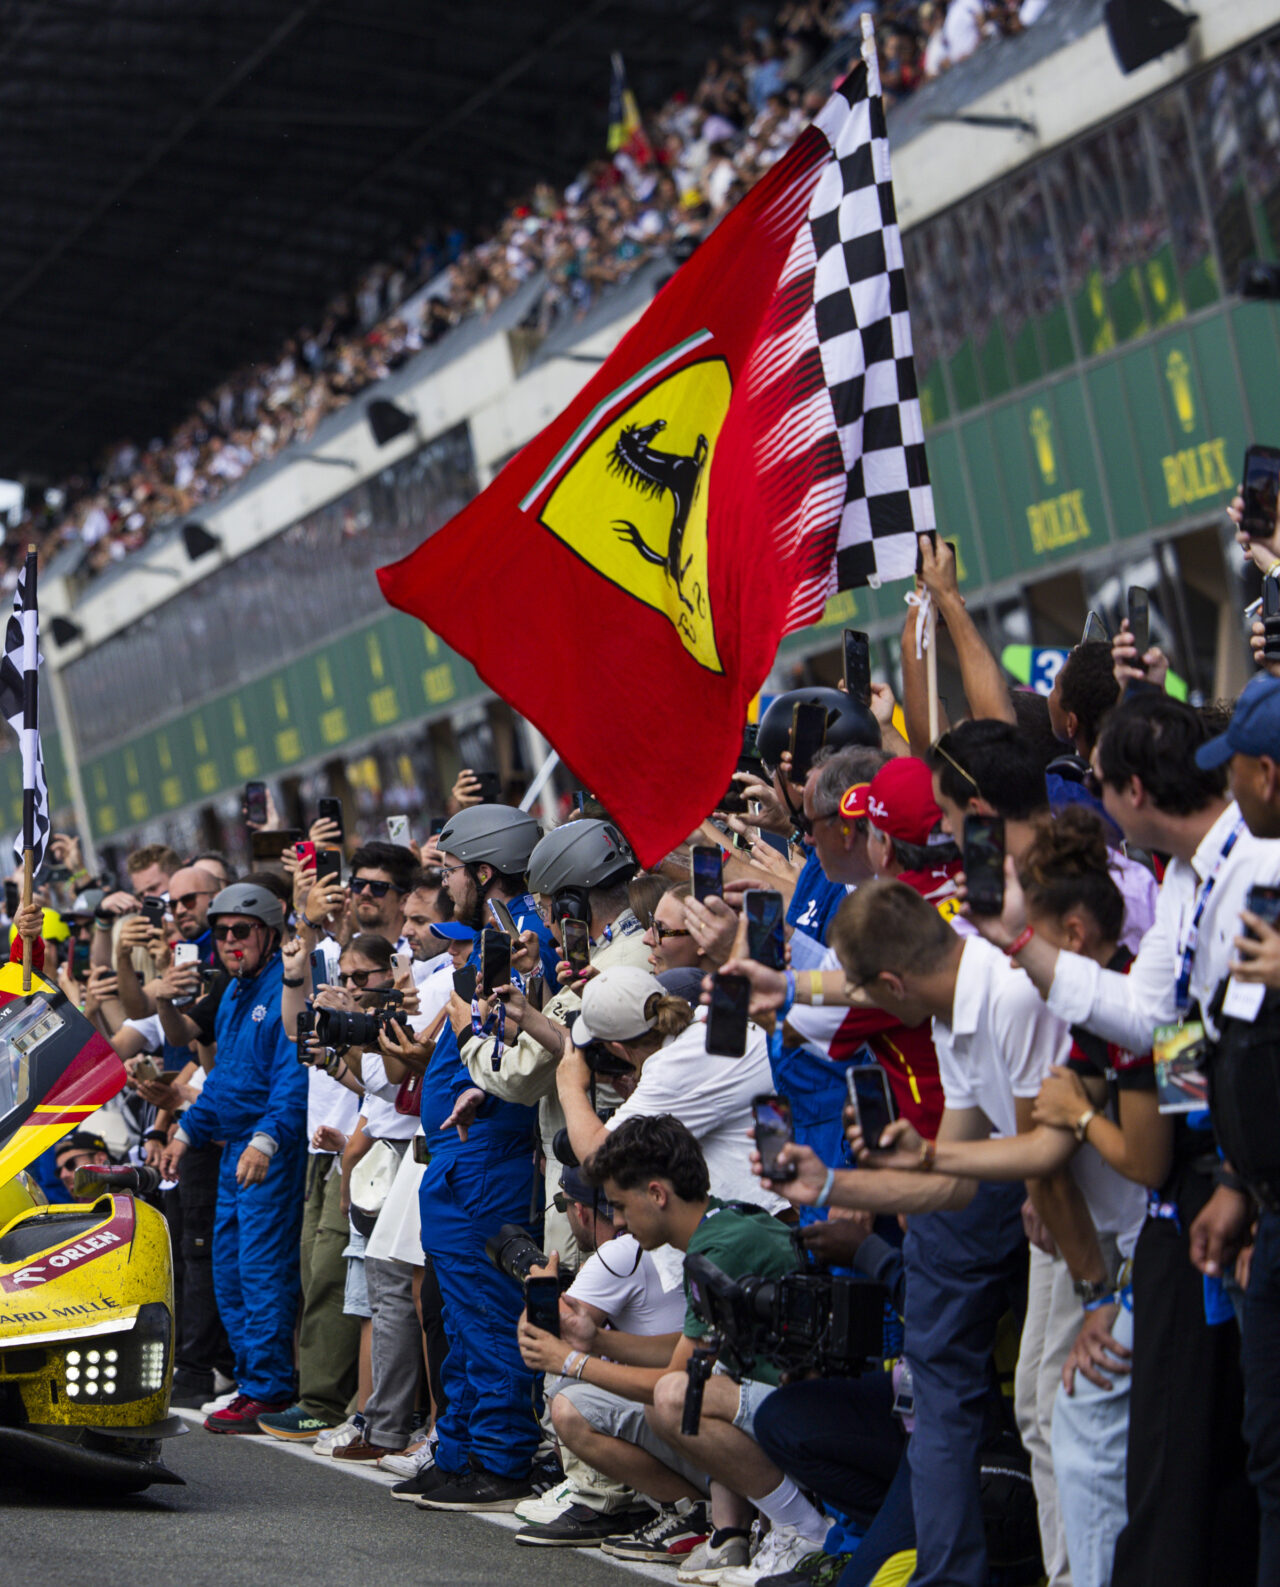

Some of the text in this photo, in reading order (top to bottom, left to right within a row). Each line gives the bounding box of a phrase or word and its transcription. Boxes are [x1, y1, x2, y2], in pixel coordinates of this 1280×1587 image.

[1161, 437, 1234, 508] ROLEX
[1027, 489, 1091, 555] ROLEX
[1, 1007, 13, 1018] YE
[48, 1231, 122, 1268] ORLEN
[52, 1296, 121, 1318] MILLE
[298, 1419, 328, 1429] HOKA
